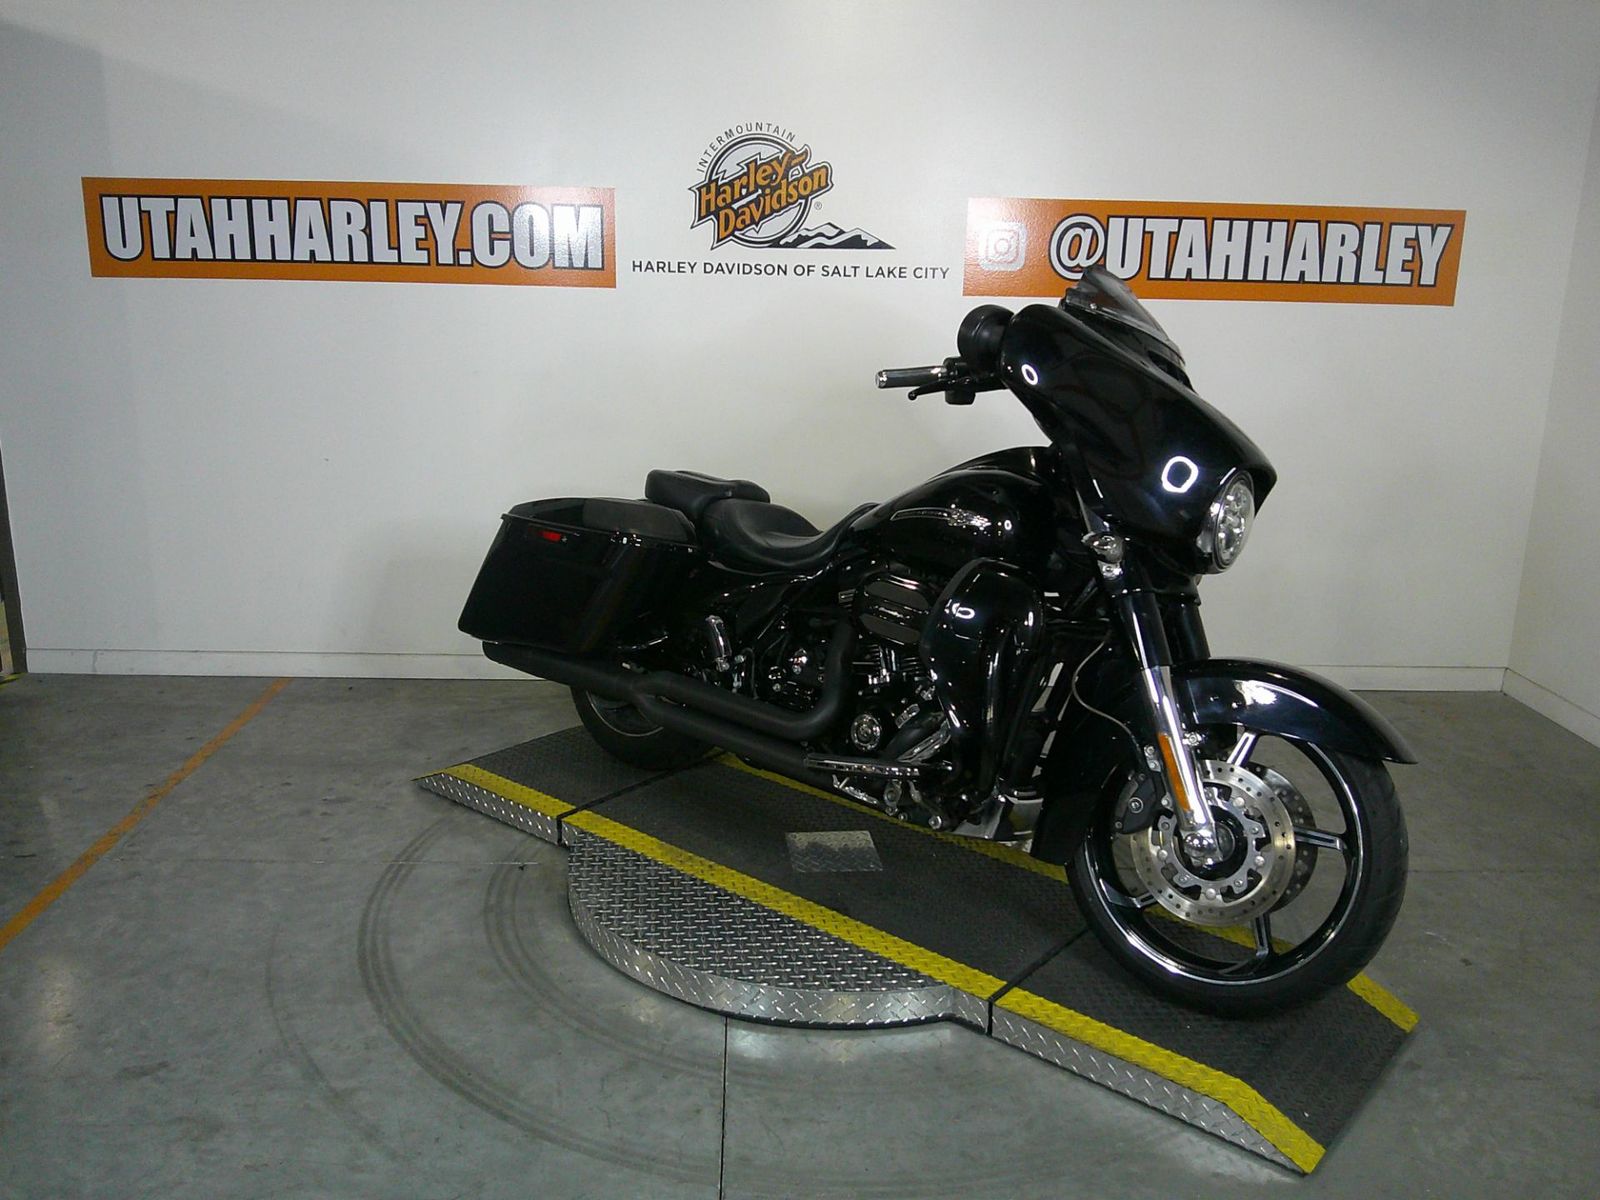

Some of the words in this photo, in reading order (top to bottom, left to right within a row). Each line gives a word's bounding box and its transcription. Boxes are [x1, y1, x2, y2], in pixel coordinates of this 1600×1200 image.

[697, 122, 796, 173] INTERMOUNTAIN
[100, 194, 605, 271] UTAHHARLEY.COM
[717, 165, 830, 238] Davidson
[632, 260, 697, 274] HARLEY
[704, 262, 787, 277] DAVIDSON
[794, 265, 816, 277] OF
[822, 266, 861, 278] SALT
[866, 266, 907, 279] LAKE
[914, 267, 950, 279] CITY
[1049, 214, 1453, 286] @UTAHHARLEY
